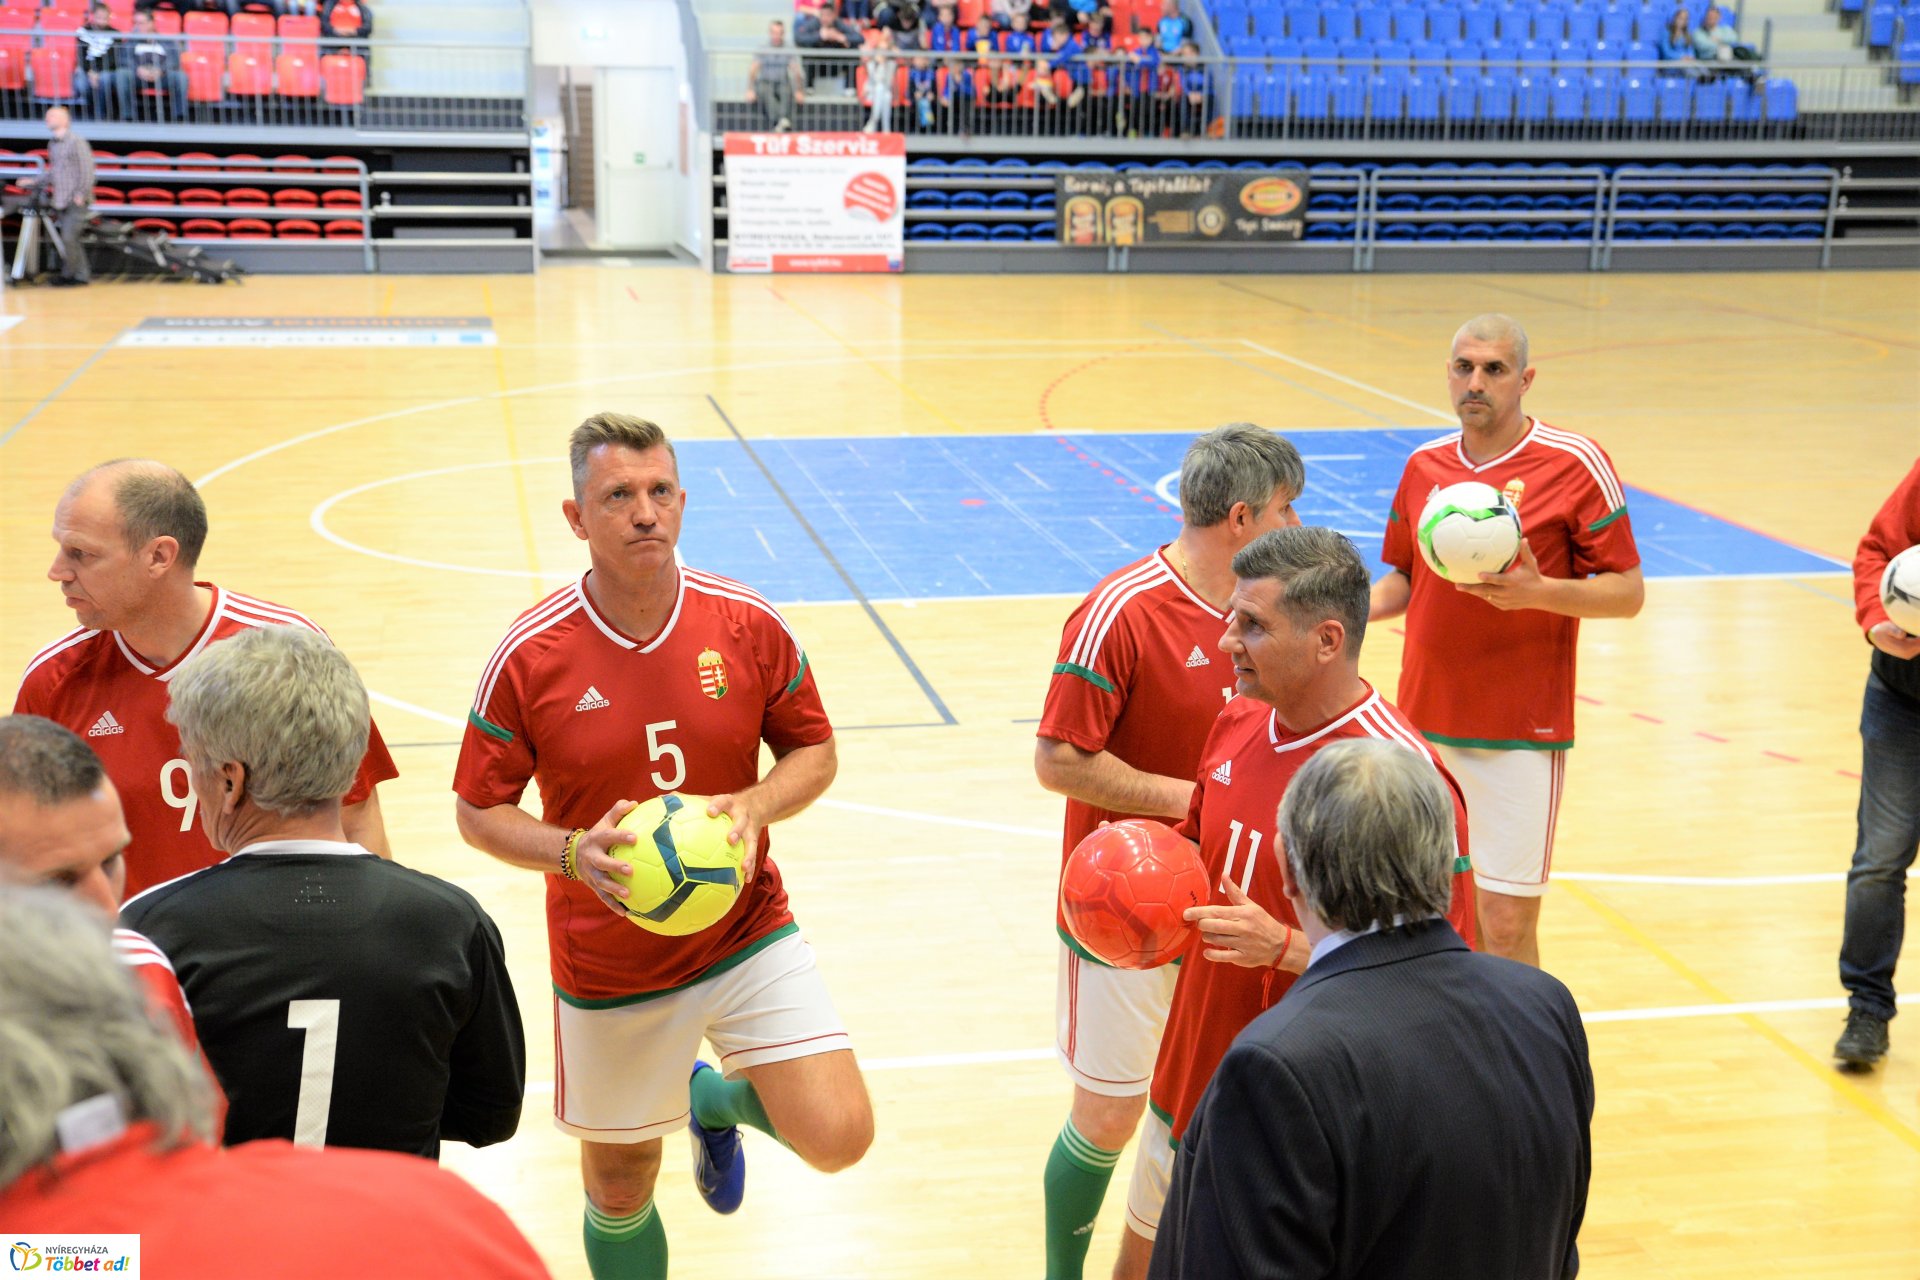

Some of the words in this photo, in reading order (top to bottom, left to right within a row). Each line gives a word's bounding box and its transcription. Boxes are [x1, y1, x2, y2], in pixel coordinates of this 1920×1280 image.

[796, 135, 880, 155] Szerviz
[1186, 658, 1210, 668] adidas
[575, 699, 610, 712] adidas
[88, 725, 125, 737] adidas
[645, 719, 687, 791] 5
[1211, 771, 1232, 786] adidas
[159, 758, 198, 832] 9
[1218, 819, 1263, 896] 11
[287, 999, 341, 1153] 1
